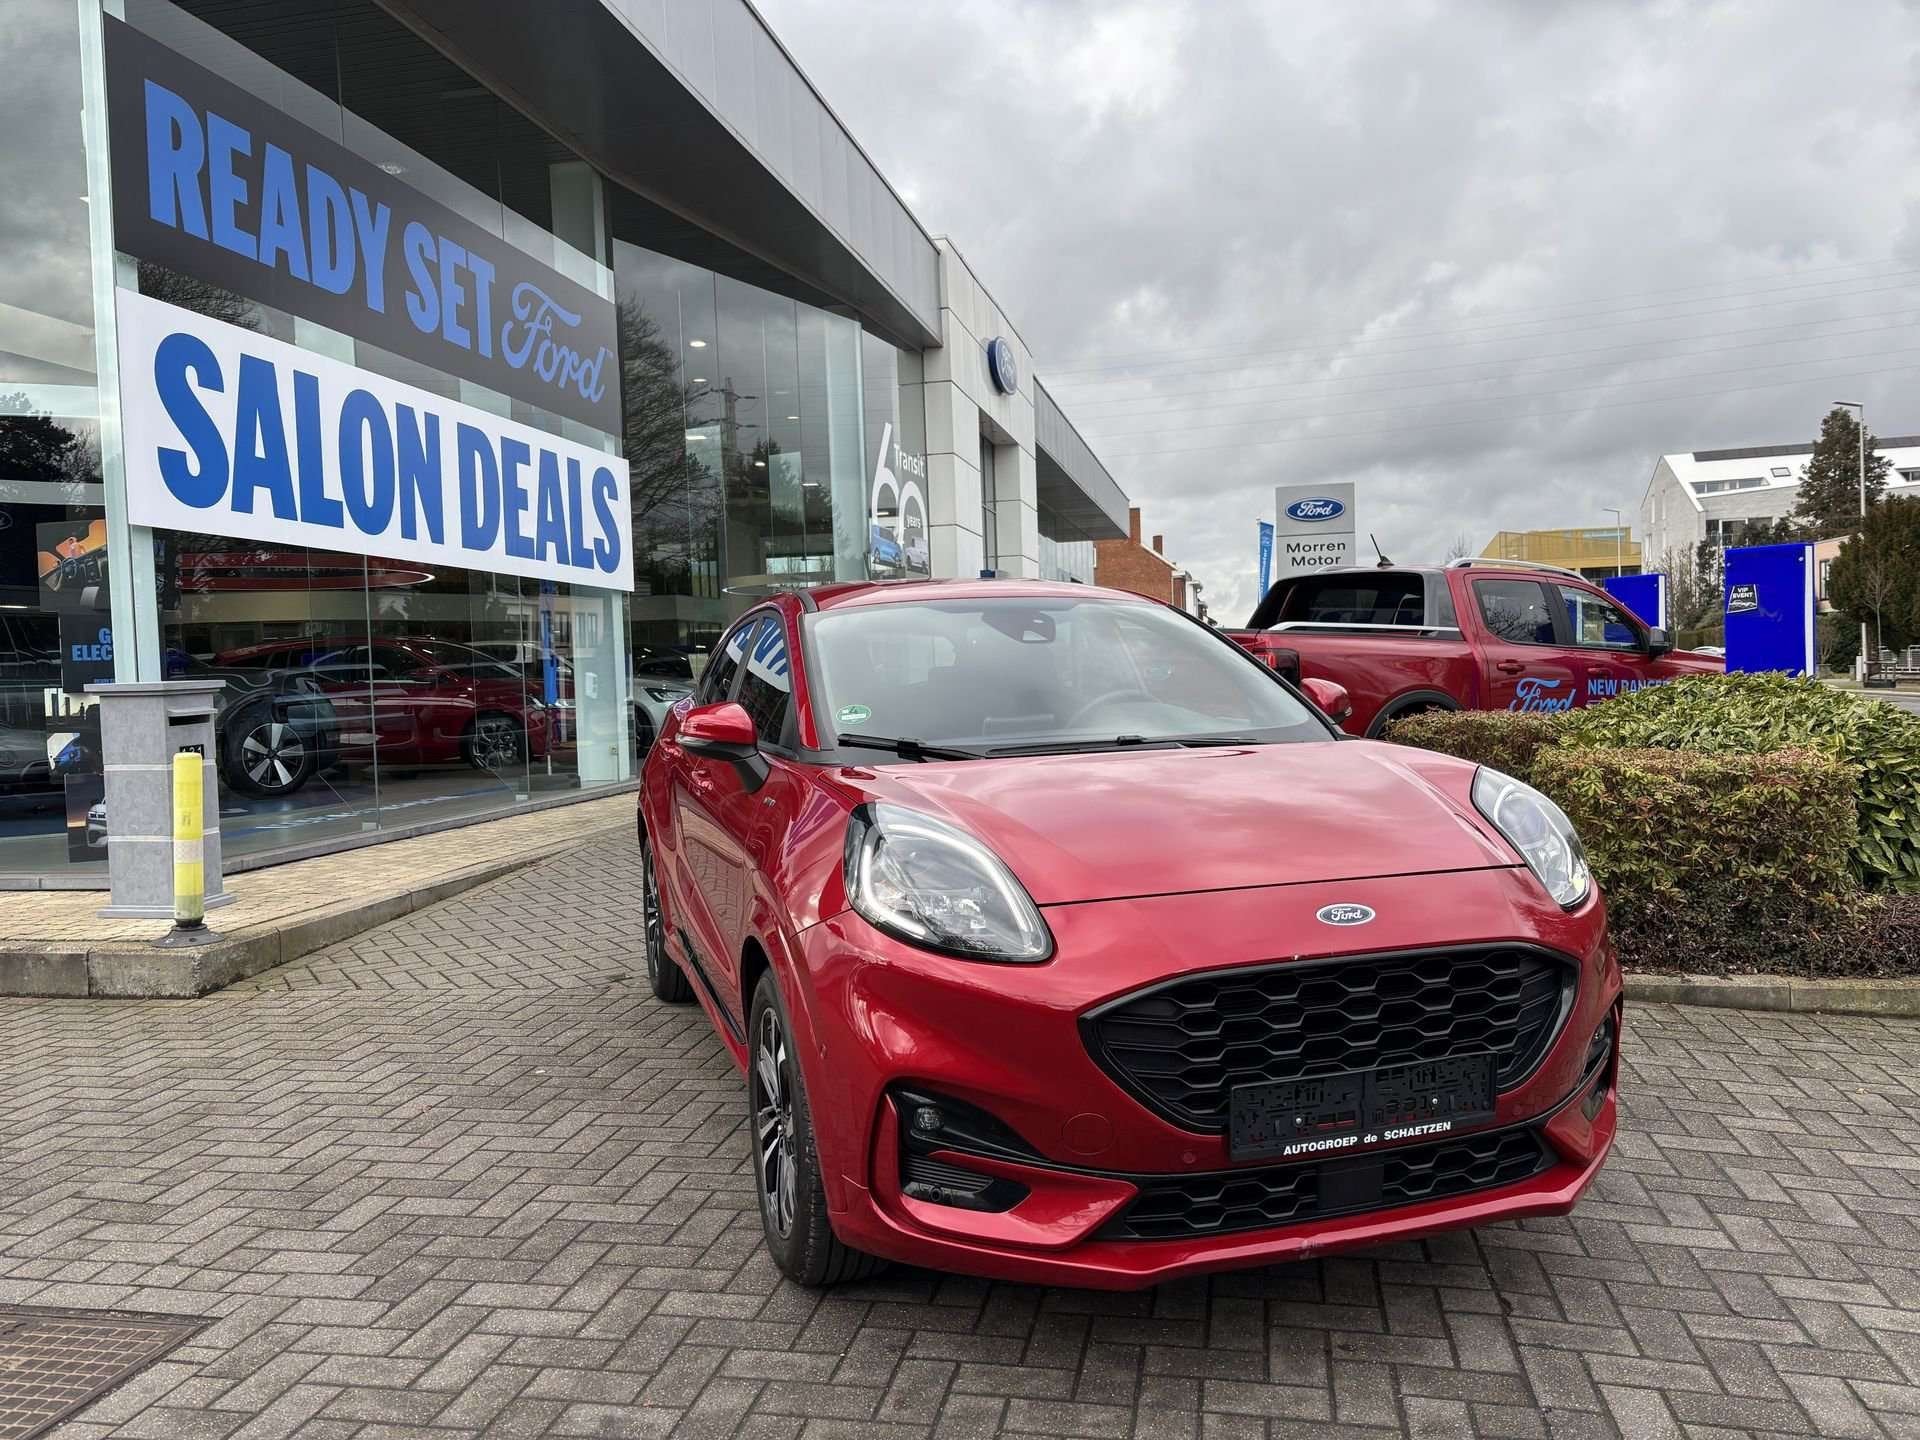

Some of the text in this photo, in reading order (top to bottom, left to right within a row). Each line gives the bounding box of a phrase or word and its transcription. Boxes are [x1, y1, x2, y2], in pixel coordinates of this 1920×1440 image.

[144, 78, 608, 404] READY SET Ford
[154, 332, 621, 574] SALON DEALS
[893, 443, 925, 479] Transit
[1296, 500, 1334, 517] Ford
[906, 514, 921, 529] years
[1286, 541, 1346, 553] Morren
[1291, 555, 1341, 567] Motor
[98, 628, 112, 644] G
[72, 644, 113, 662] ELEC
[1508, 677, 1577, 712] Ford
[1587, 679, 1618, 696] NEW
[1331, 906, 1364, 921] Ford
[1283, 1121, 1451, 1156] AUTOGROEP de SCHAETZEN
